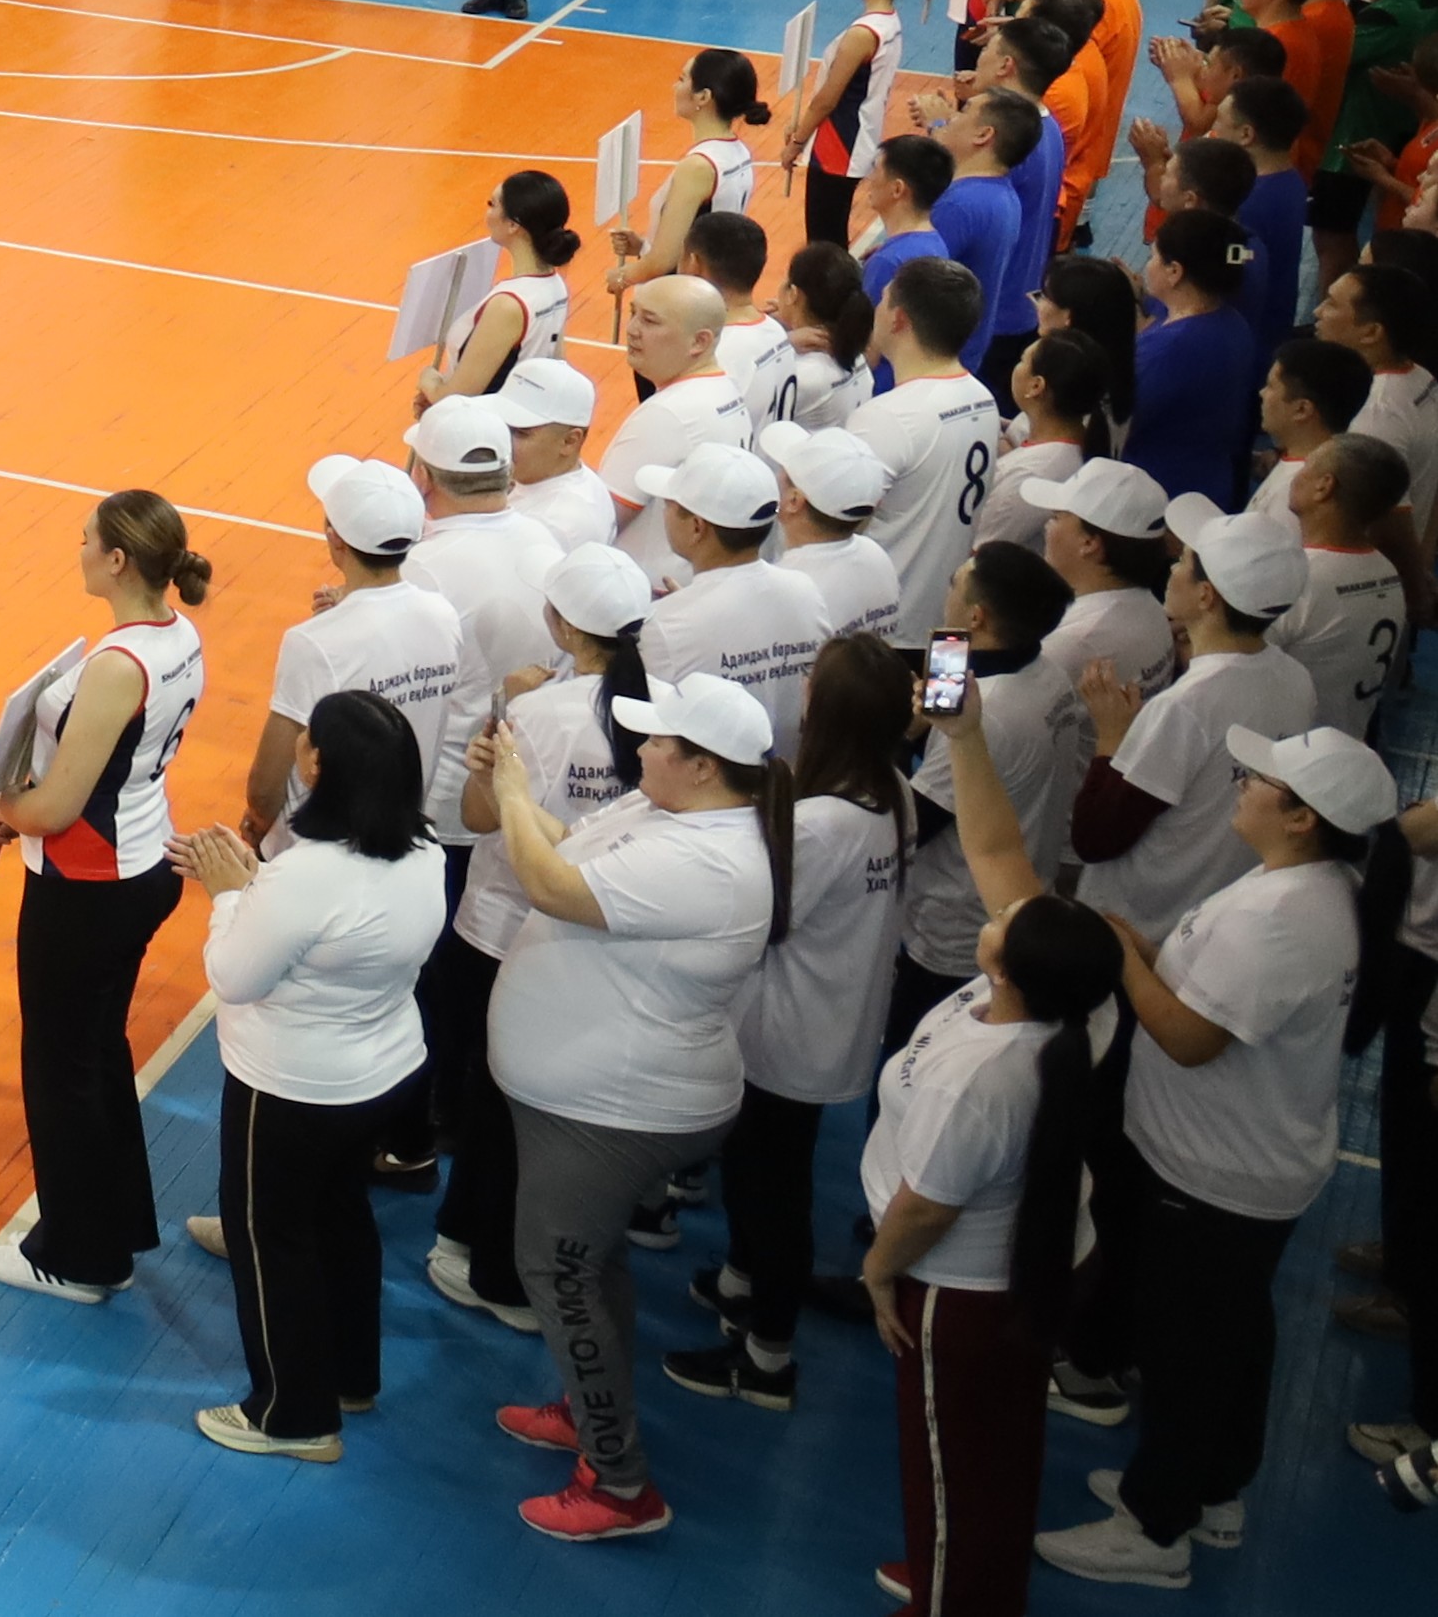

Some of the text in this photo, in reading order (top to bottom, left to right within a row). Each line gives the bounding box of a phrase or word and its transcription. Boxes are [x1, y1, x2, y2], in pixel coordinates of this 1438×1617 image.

[958, 440, 990, 526] 8
[1354, 618, 1397, 701] 3
[554, 1237, 591, 1328] MOVE
[569, 1338, 605, 1382] TO
